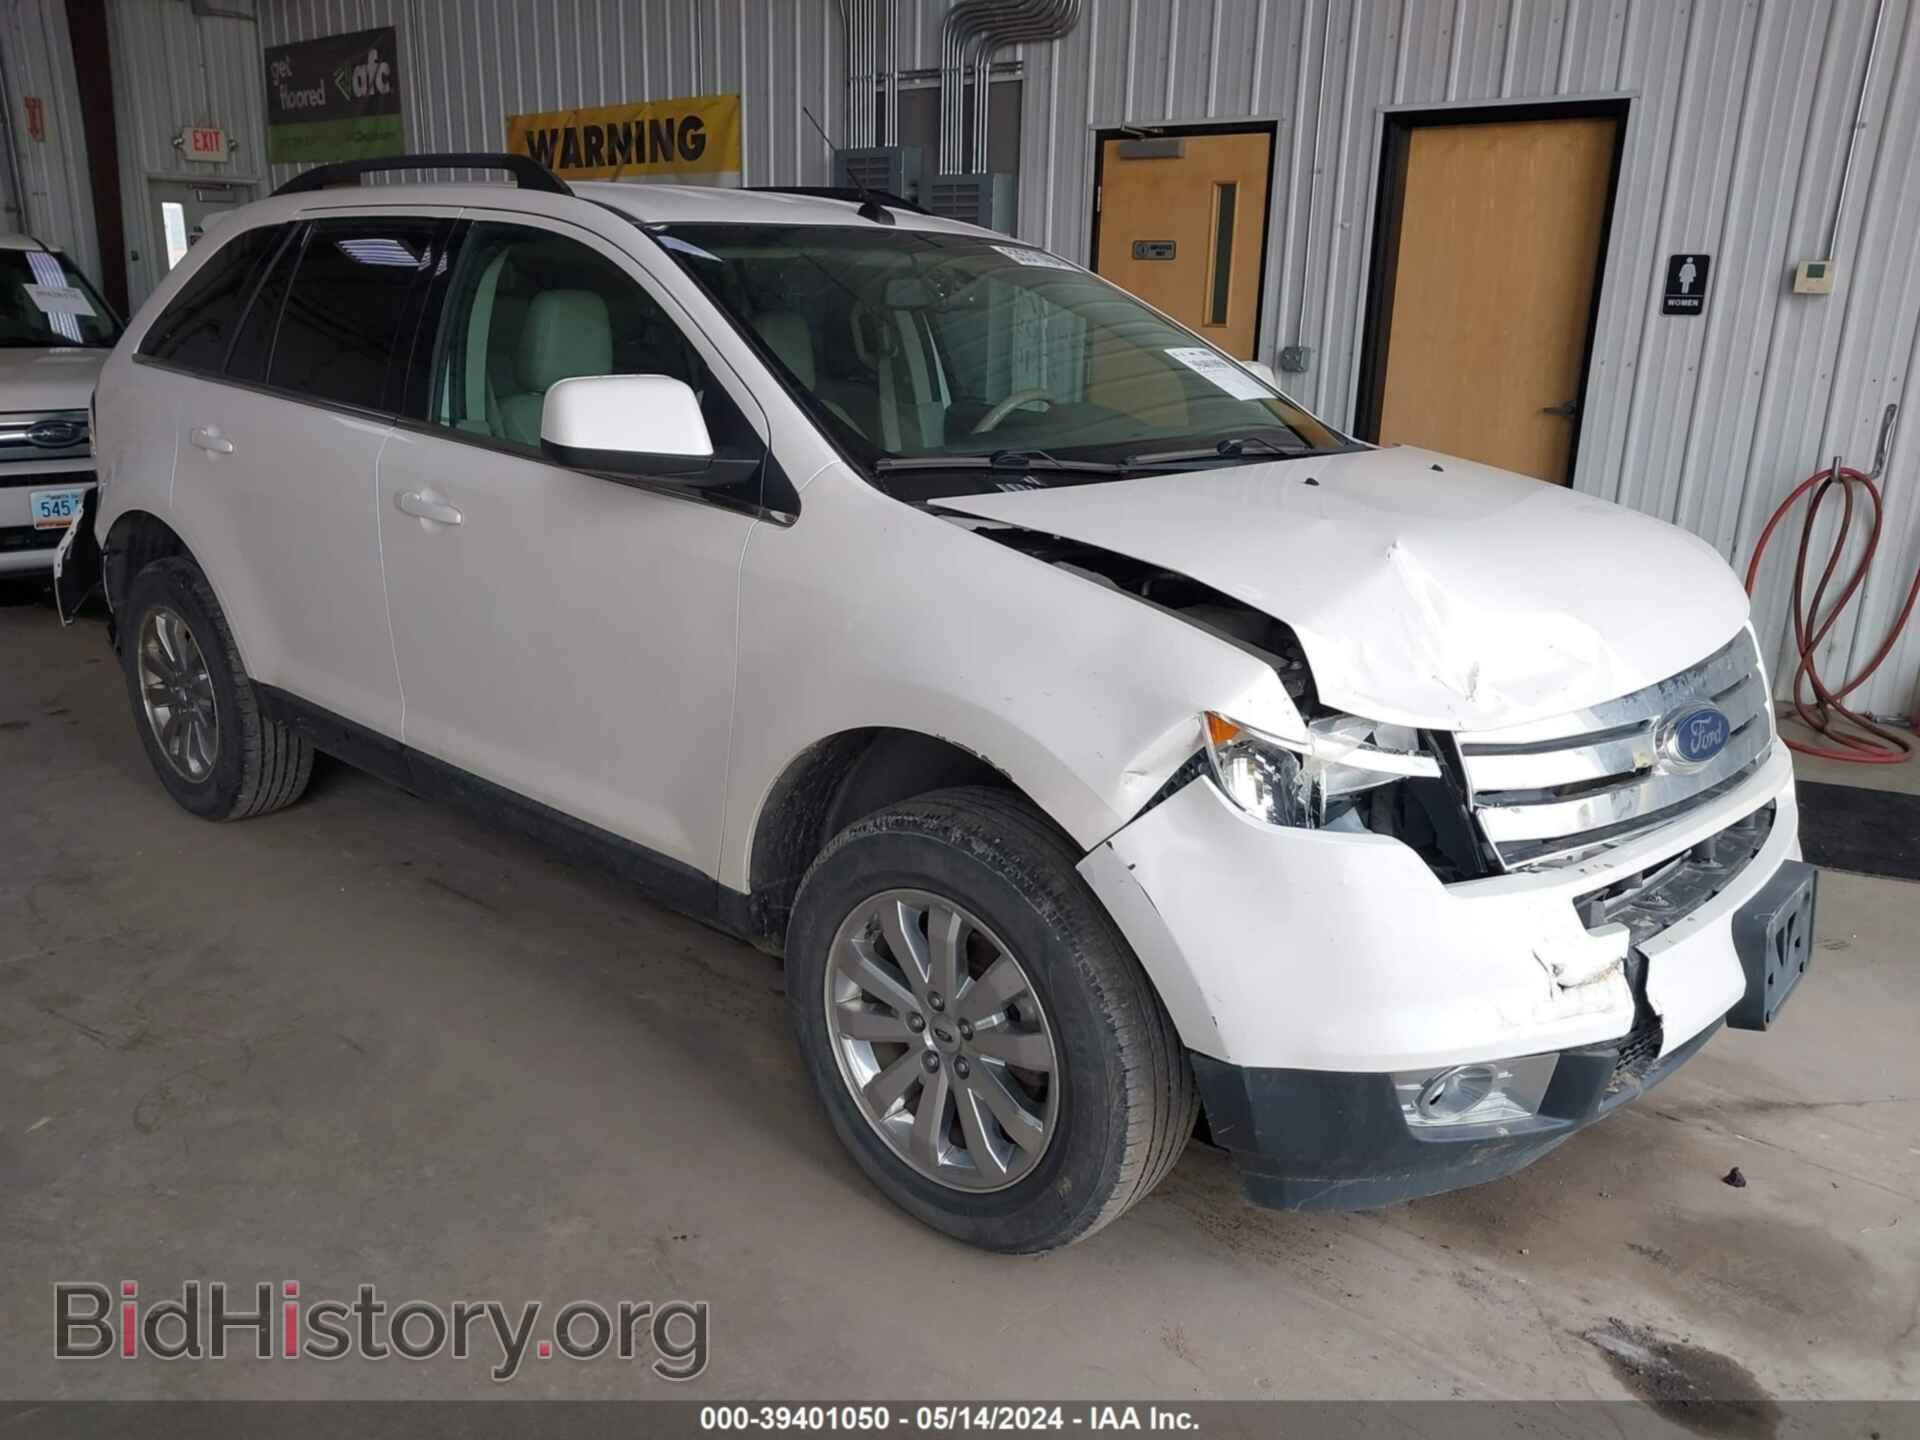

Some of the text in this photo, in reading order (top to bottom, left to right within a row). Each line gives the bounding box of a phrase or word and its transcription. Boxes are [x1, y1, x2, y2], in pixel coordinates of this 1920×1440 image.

[271, 56, 292, 86] get
[352, 49, 391, 98] afc
[279, 78, 327, 111] floored
[192, 131, 221, 152] EXIT
[526, 115, 706, 169] WARNING
[1667, 298, 1699, 307] WOMEN
[1690, 715, 1723, 755] Ford
